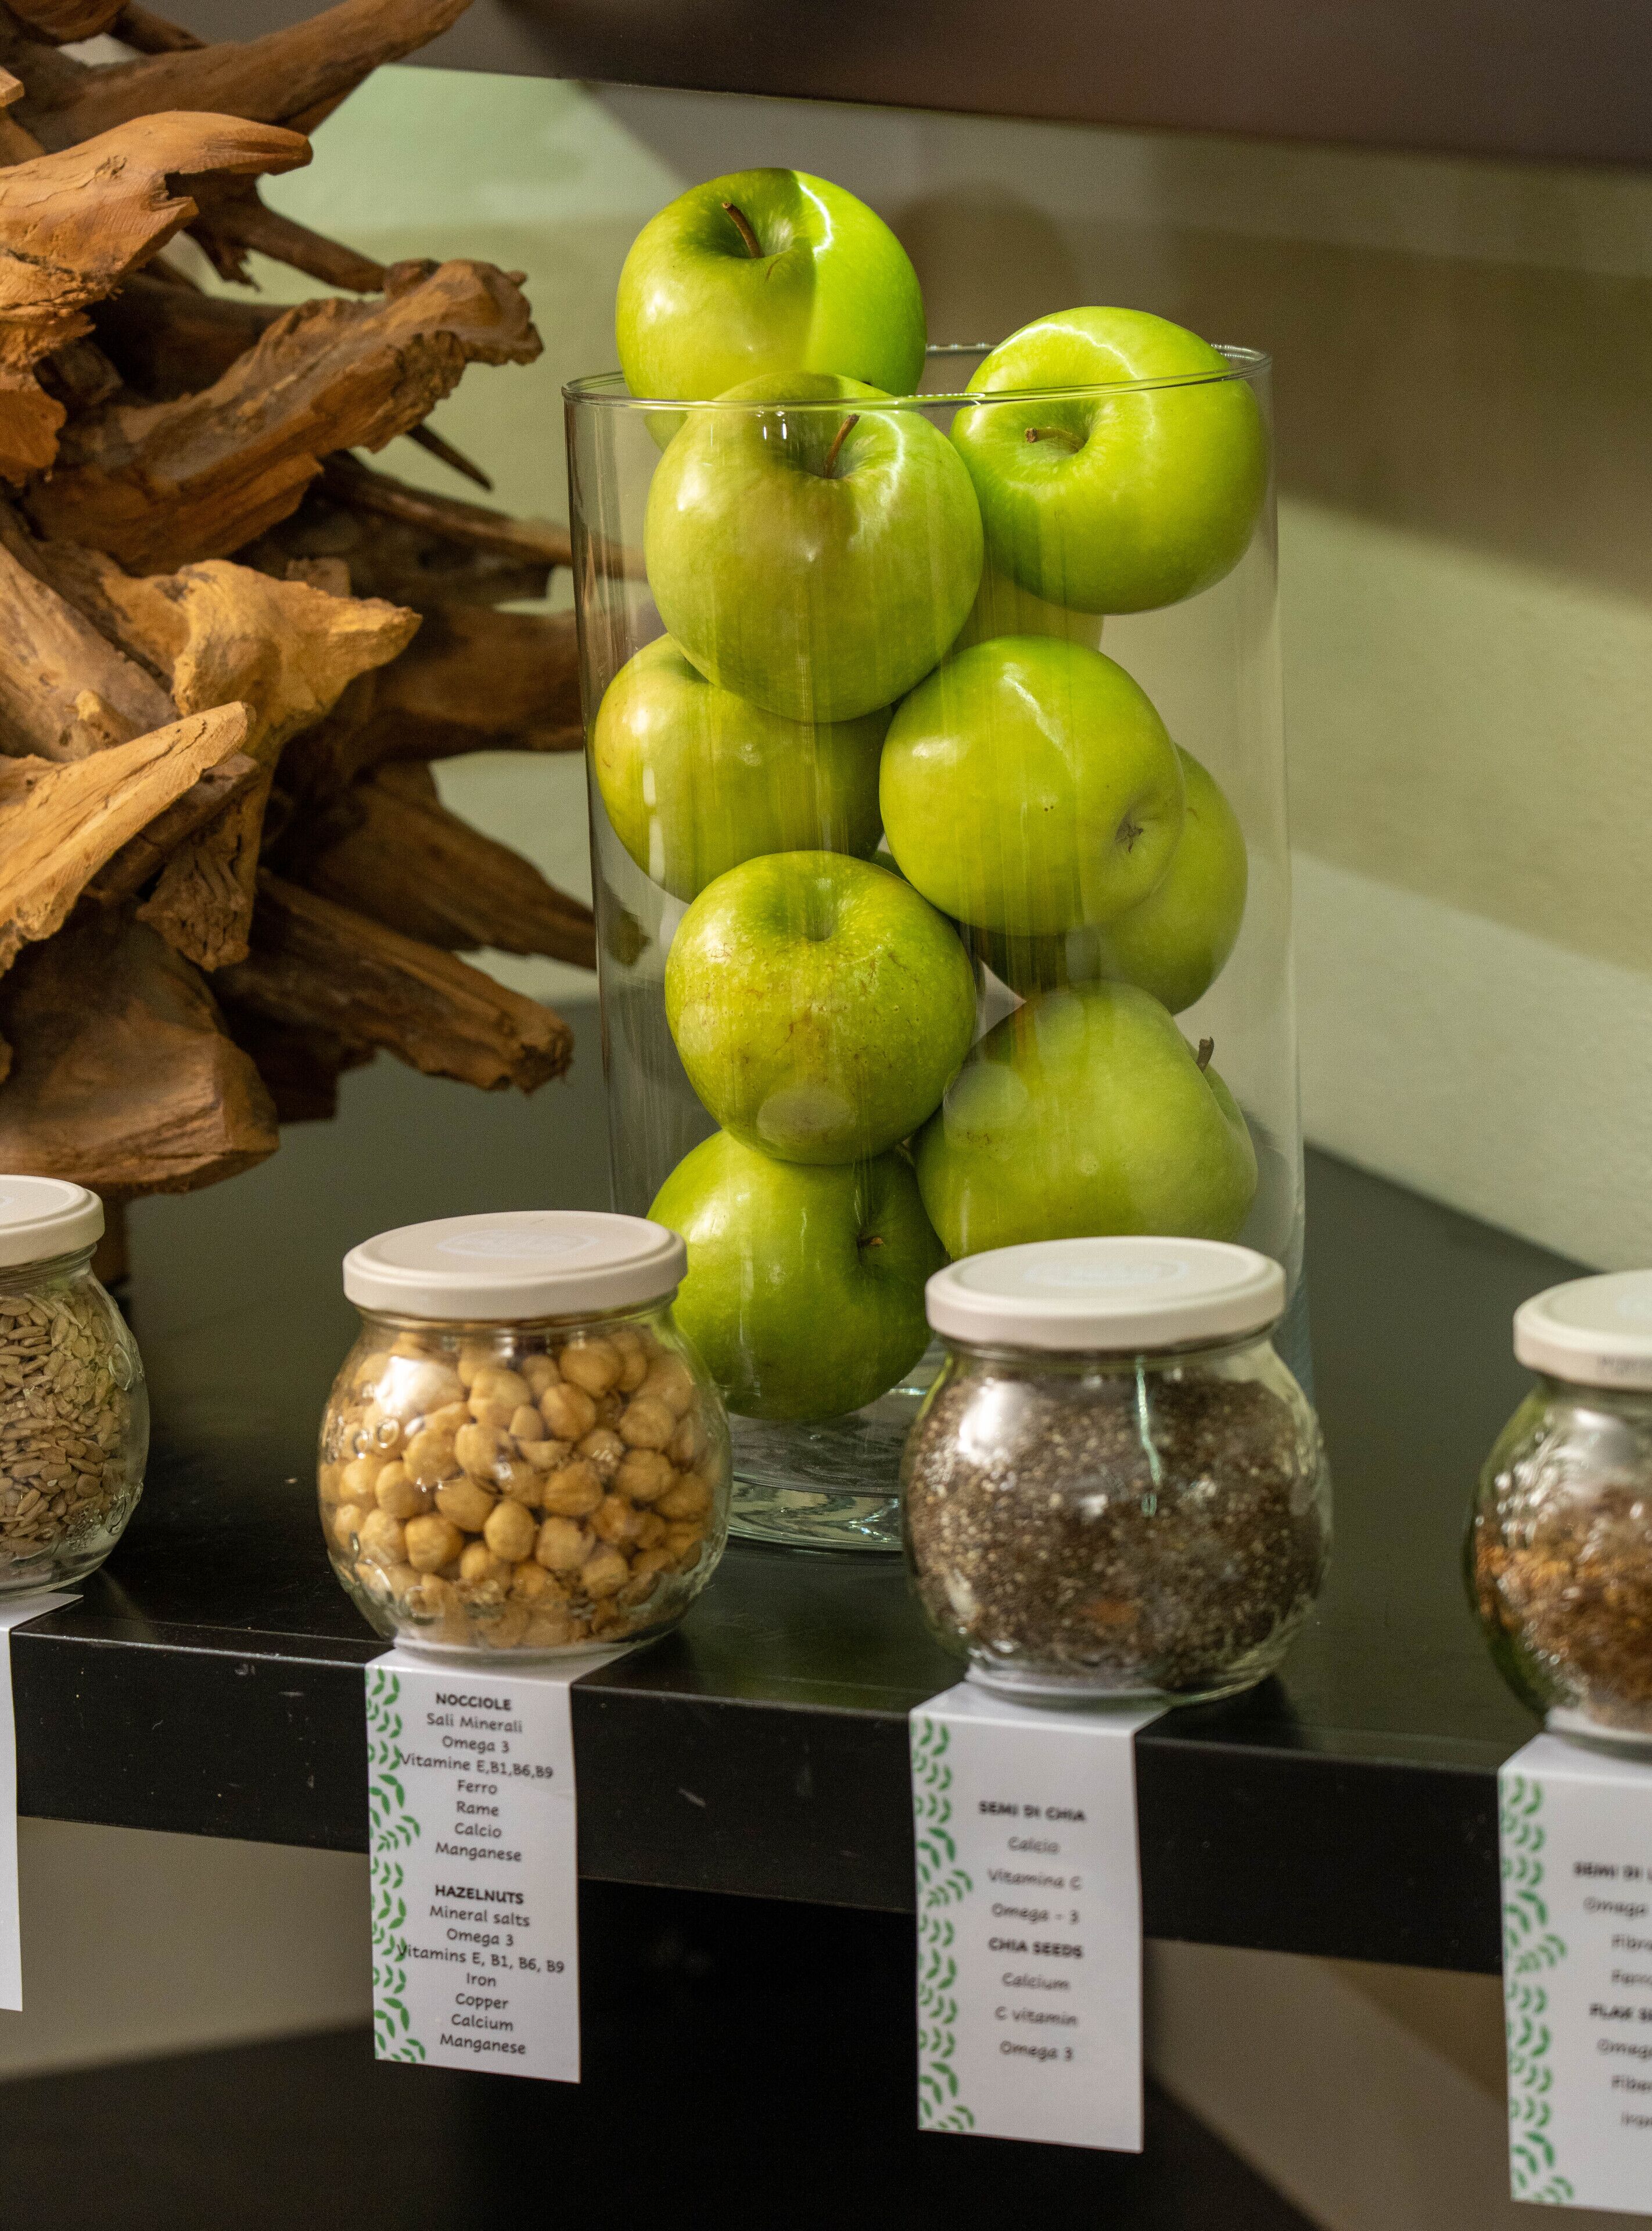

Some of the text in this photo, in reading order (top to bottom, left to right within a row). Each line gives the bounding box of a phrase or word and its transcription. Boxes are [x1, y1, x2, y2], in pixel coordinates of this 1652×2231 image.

[436, 1692, 512, 1710] NOCCIOLE
[426, 1713, 523, 1734] Sali Minerali
[443, 1736, 509, 1753] Omega 3
[400, 1753, 471, 1770] Vitamine
[457, 1780, 497, 1795] Ferro
[457, 1801, 499, 1816] Rame
[979, 1801, 1085, 1822] SEMI DI CHIA
[455, 1822, 502, 1838] Calcio
[436, 1842, 522, 1861] Manganese
[1008, 1836, 1060, 1854] Calcio
[1070, 1875, 1081, 1890] C
[435, 1885, 524, 1904] HAZELNUTS
[430, 1905, 530, 1927] Mineral salts
[992, 1902, 1048, 1924] Omega
[1070, 1910, 1079, 1924] 3
[447, 1928, 513, 1946] Omega 3
[989, 1937, 1083, 1959] CHIA SEEDS
[397, 1944, 564, 1972] Vitamins E, B1, B6, B9
[467, 1972, 495, 1987] Iron
[1001, 1972, 1070, 1990] Calcium
[455, 1993, 508, 2010] Copper
[452, 2014, 513, 2031] Calcium
[995, 2006, 1078, 2026] C vitamin
[440, 2034, 526, 2054] Manganese
[999, 2040, 1073, 2061] Omega 3
